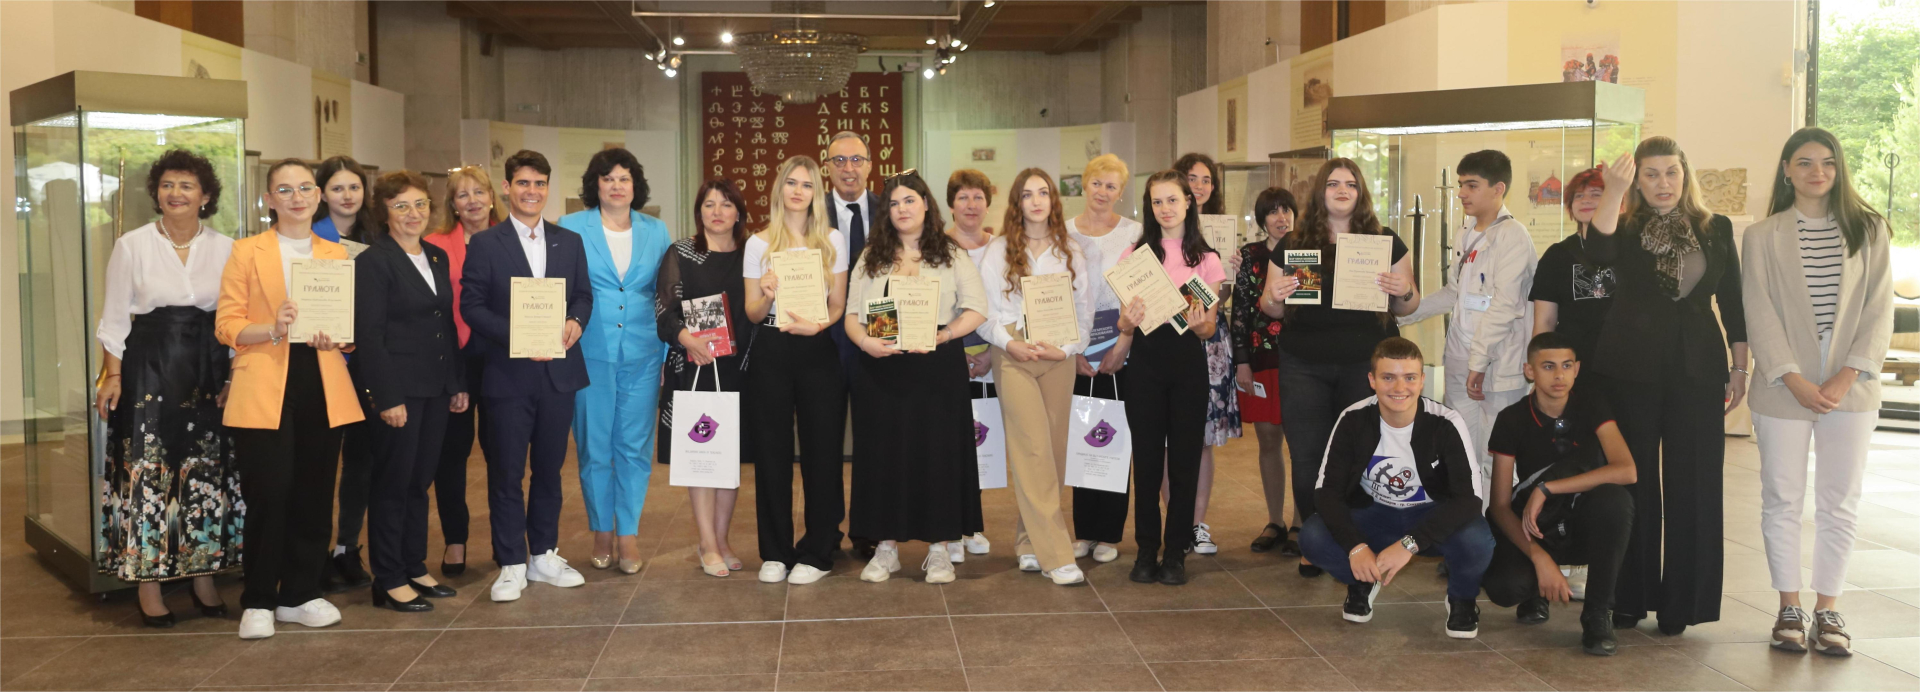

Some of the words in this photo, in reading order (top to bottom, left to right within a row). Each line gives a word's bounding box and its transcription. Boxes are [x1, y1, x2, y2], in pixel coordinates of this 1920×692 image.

[860, 86, 870, 98] В
[880, 86, 889, 98] Г
[817, 102, 830, 115] Д
[857, 102, 872, 114] Ж
[861, 119, 870, 130] К
[881, 134, 891, 145] П
[1348, 258, 1378, 266] ГРАМОТА
[1126, 270, 1154, 291] ГРАМОТА
[1034, 296, 1062, 304] ГРАМОТА
